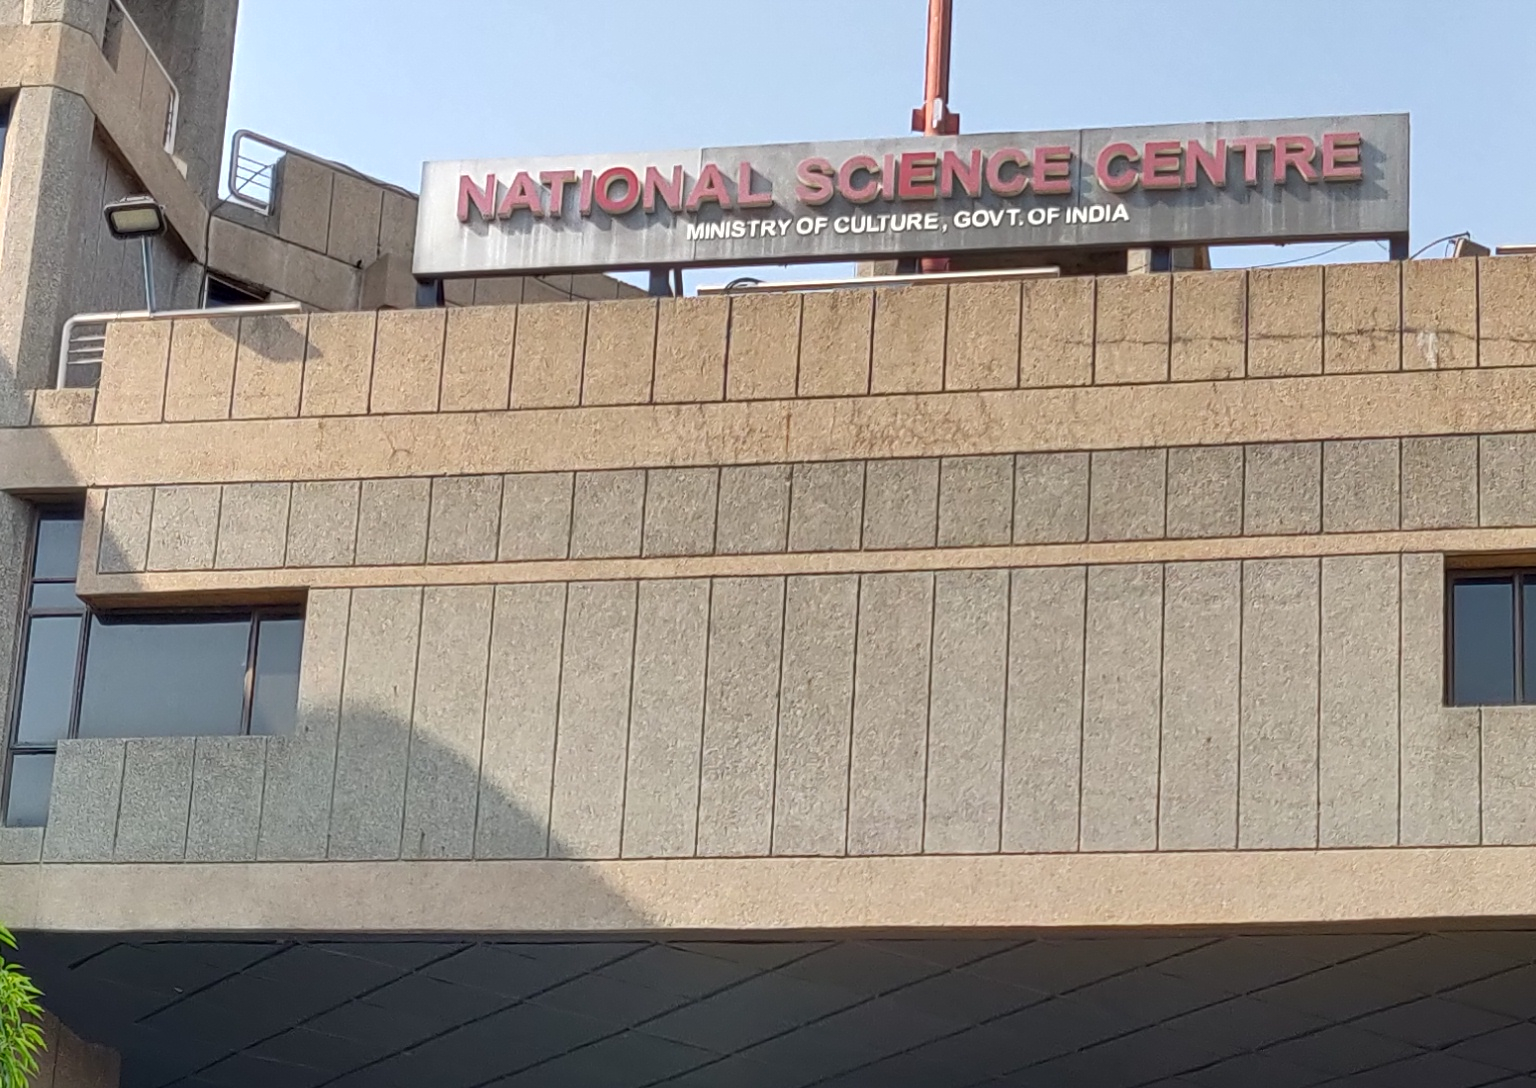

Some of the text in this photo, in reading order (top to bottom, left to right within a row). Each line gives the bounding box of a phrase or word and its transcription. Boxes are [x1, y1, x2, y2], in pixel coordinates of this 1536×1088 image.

[456, 131, 1362, 222] NATIONAL SCIENCE CENTRE
[686, 218, 794, 241] MINISTRY
[796, 216, 830, 236] OF
[954, 208, 1023, 229] GOVT.
[1027, 207, 1060, 226] OF
[1065, 203, 1130, 223] INDIA
